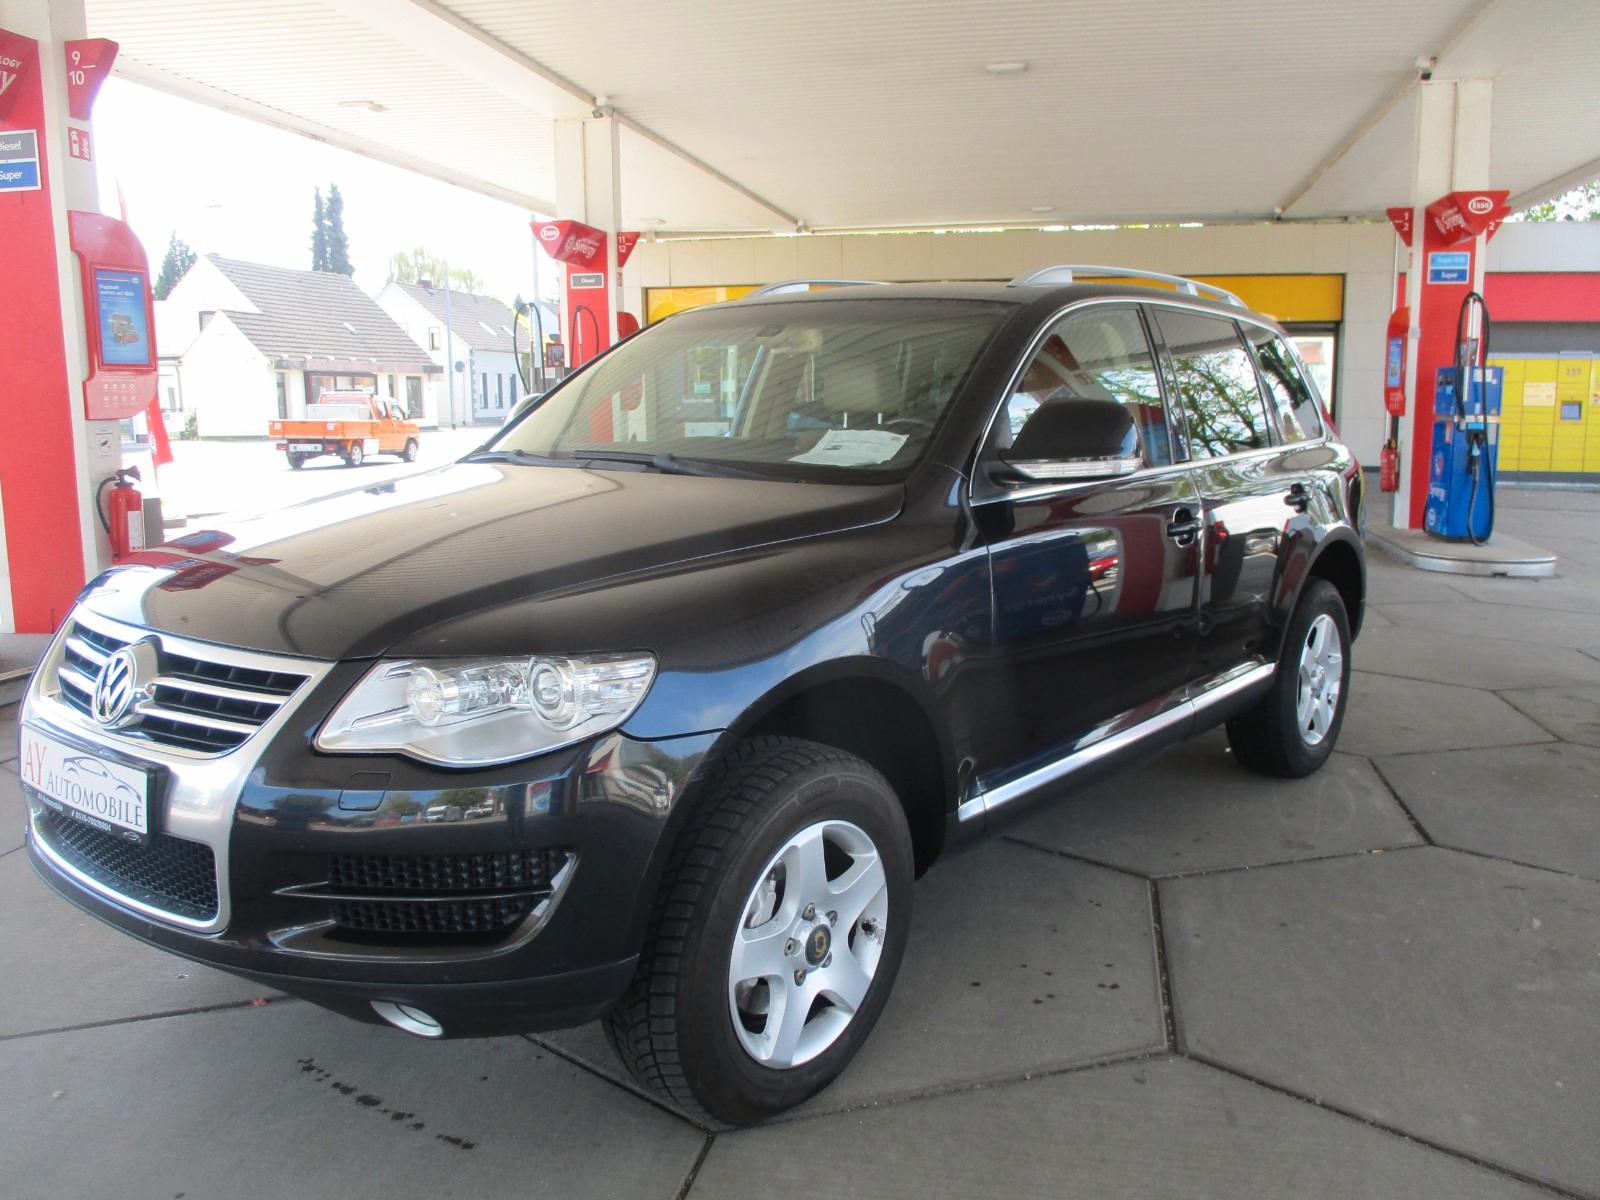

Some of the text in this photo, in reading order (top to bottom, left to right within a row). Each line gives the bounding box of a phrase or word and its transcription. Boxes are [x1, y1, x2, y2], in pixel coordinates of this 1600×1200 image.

[72, 50, 81, 66] 9
[69, 70, 85, 86] 10
[23, 738, 47, 786] AY
[46, 770, 144, 828] AUTOMOBILE
